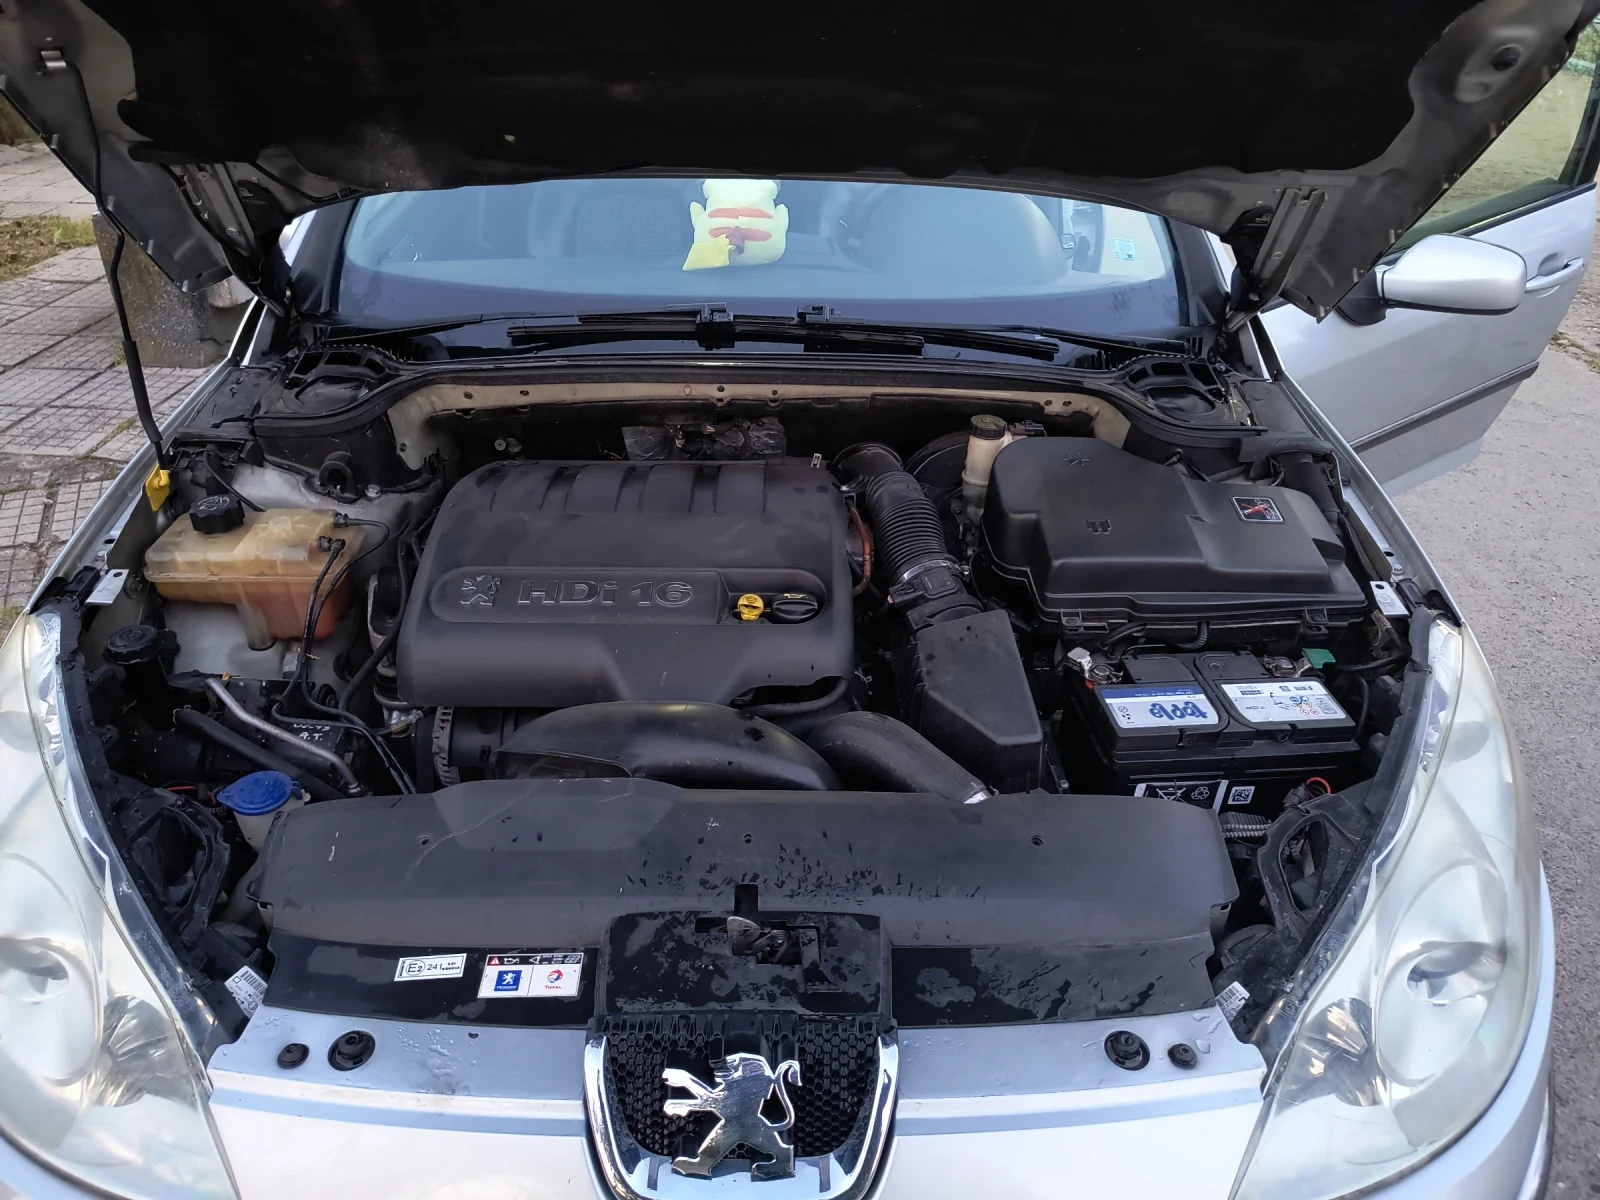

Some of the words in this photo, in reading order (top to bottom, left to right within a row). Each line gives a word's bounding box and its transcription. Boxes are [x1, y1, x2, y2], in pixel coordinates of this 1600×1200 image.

[517, 580, 618, 605] HDi
[630, 581, 694, 607] 16
[1149, 701, 1208, 721] topla
[427, 963, 438, 971] 24
